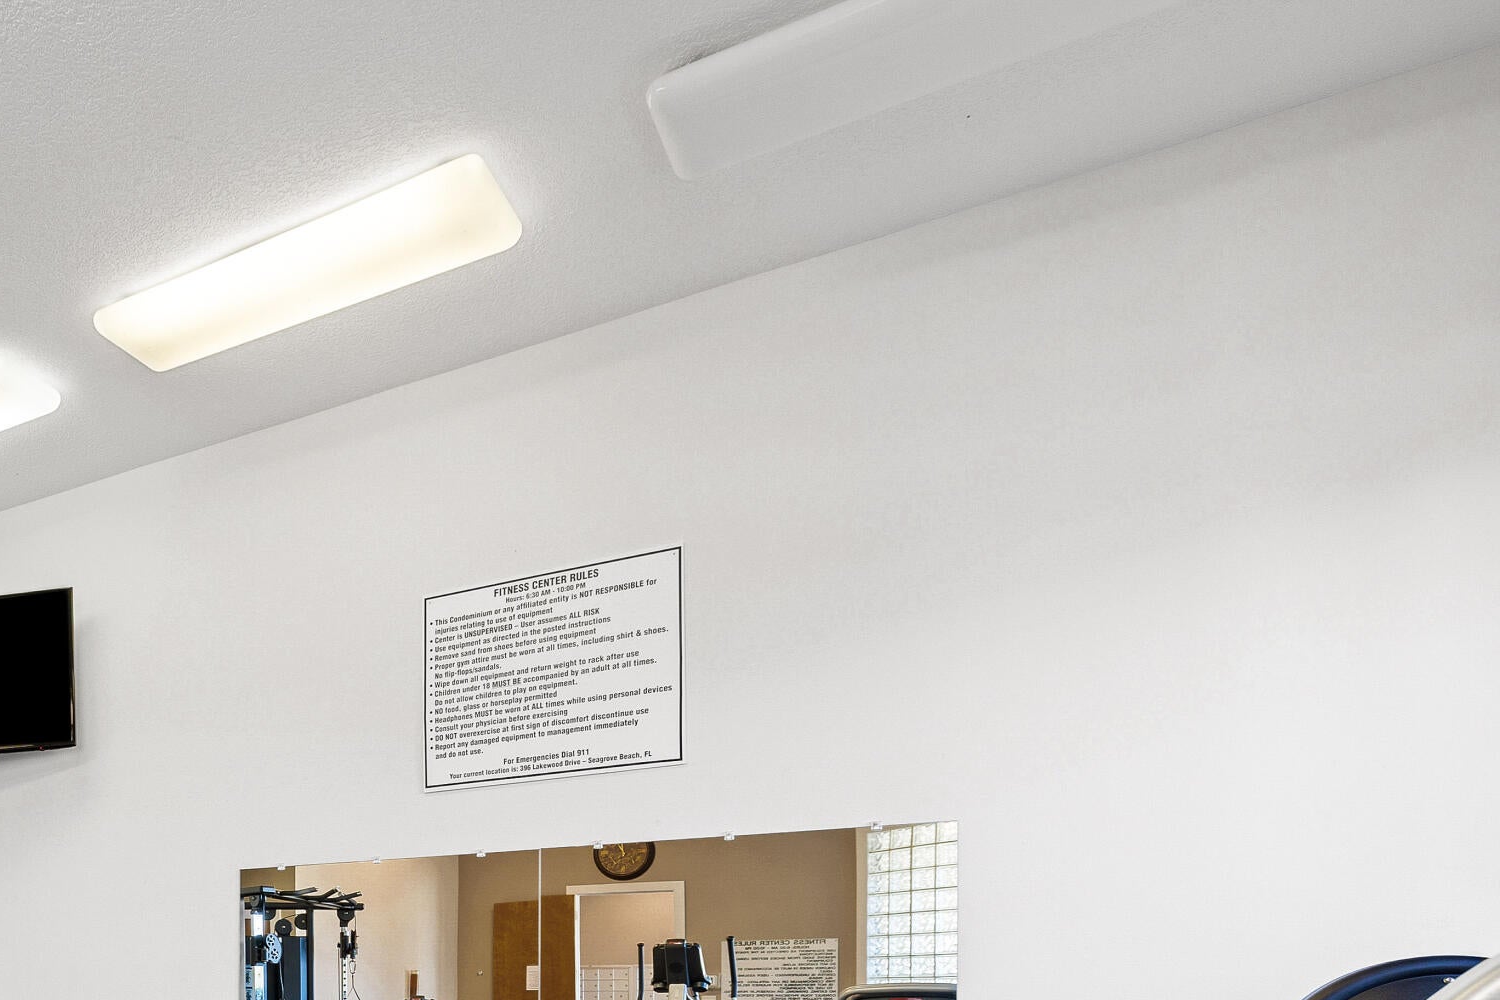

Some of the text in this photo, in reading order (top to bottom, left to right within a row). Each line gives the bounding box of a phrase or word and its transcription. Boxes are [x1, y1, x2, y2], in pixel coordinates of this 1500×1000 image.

[494, 568, 598, 597] FITNESS CENTER RULES
[450, 610, 492, 623] Condominium
[516, 598, 547, 610] affiliated
[549, 595, 569, 604] entity
[580, 590, 593, 598] NOT
[596, 580, 644, 595] RESPONSIBLE
[435, 636, 455, 644] Center
[464, 624, 512, 638] UNSUPERVISED
[537, 615, 567, 625] assumes
[584, 608, 599, 616] RISK
[448, 638, 481, 651] equipment
[492, 632, 520, 642] directed
[543, 623, 566, 635] posted
[568, 617, 611, 629] instructions
[434, 662, 455, 670] Proper
[457, 660, 470, 668] gym
[471, 656, 489, 664] attire
[491, 652, 507, 660] must
[557, 642, 579, 650] times,
[581, 635, 614, 646] including
[616, 631, 634, 640] shirt
[644, 627, 668, 635] shoes.
[434, 689, 460, 697] Children
[492, 679, 510, 687] MUST
[523, 670, 568, 683] accompanied
[592, 664, 610, 673] adult
[634, 658, 657, 666] times.
[480, 670, 515, 681] equipment
[531, 665, 551, 673] return
[553, 660, 577, 669] weight
[435, 714, 473, 724] Headphones
[475, 710, 493, 718] MUST
[609, 689, 641, 700] personal
[643, 685, 672, 694] devices
[459, 728, 500, 738] overexercise
[551, 715, 589, 726] discomfort
[591, 710, 633, 721] discontinue
[516, 753, 560, 763] Emergencies
[532, 761, 563, 770] Lakewood
[588, 756, 618, 764] Seagrove
